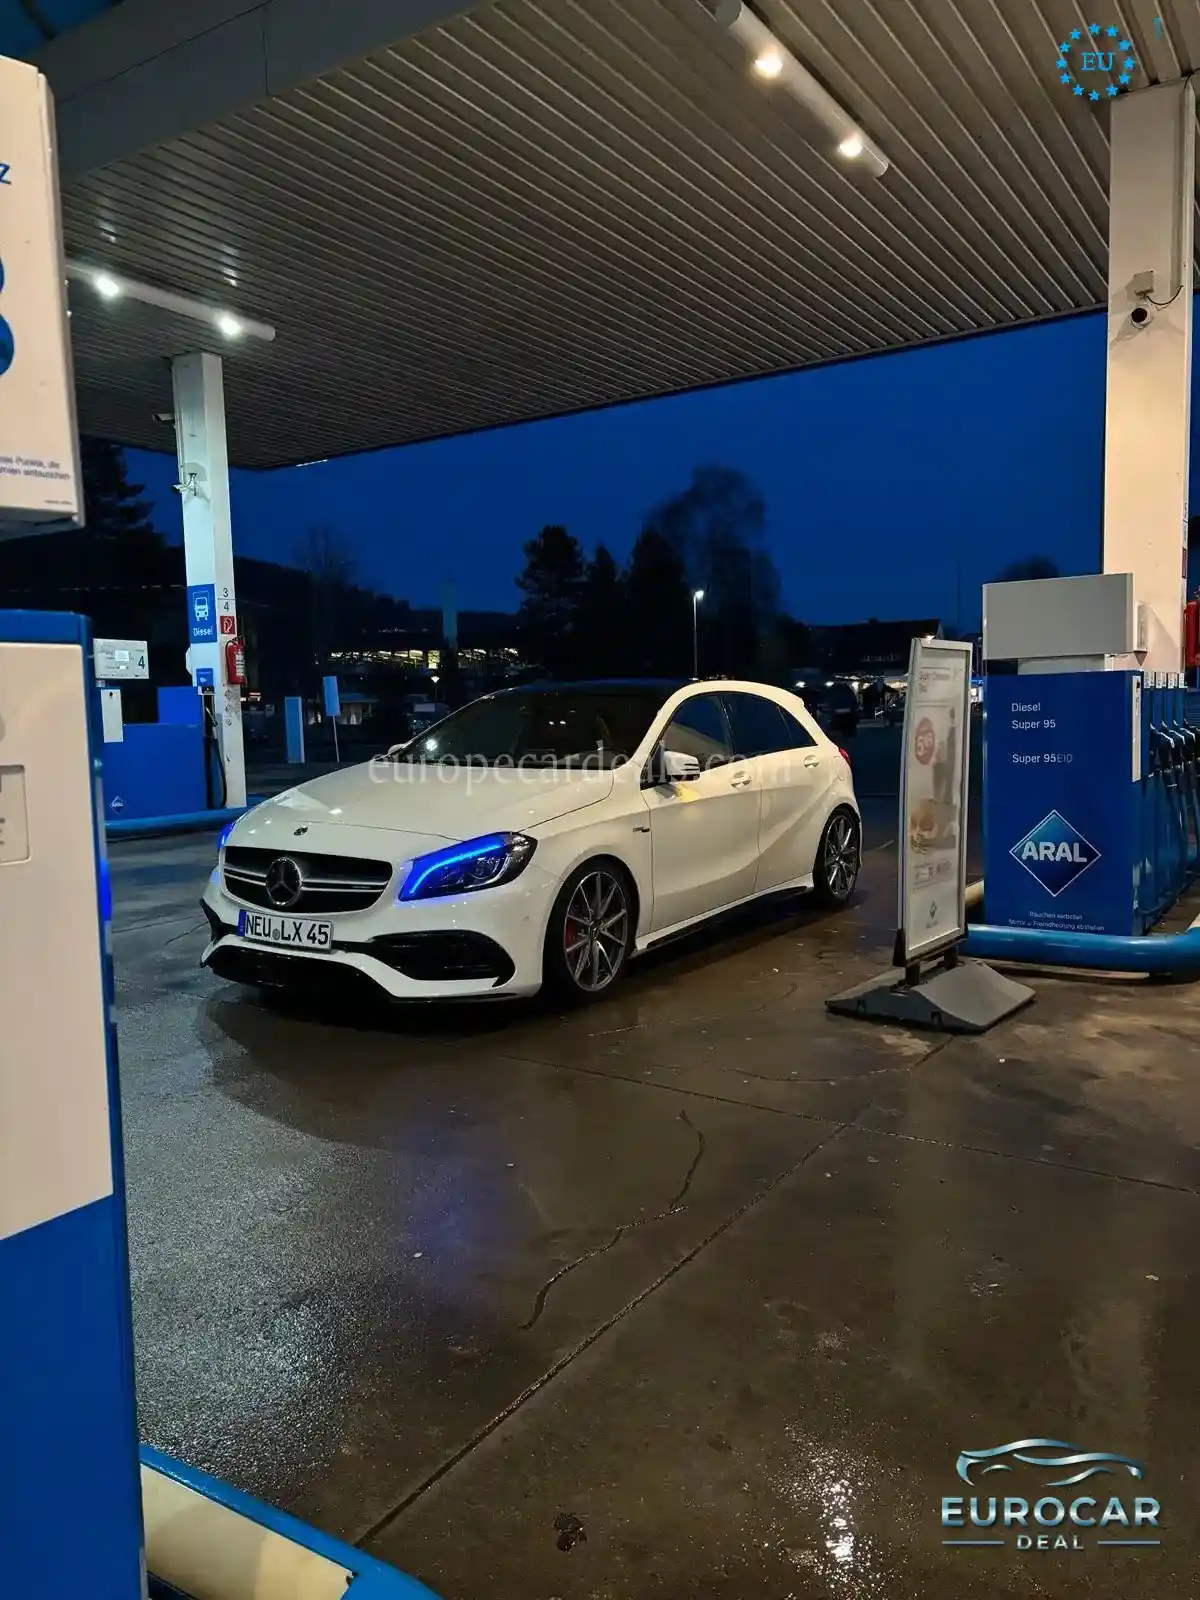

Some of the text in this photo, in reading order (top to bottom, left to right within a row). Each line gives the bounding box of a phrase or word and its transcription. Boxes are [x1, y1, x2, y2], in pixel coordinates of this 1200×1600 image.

[222, 587, 229, 598] 3
[223, 601, 230, 612] 4
[193, 626, 213, 637] Diesel
[138, 655, 146, 670] 4
[1011, 702, 1041, 712] Diesel
[1011, 719, 1056, 731] Super 95
[1012, 752, 1041, 765] Super
[1021, 840, 1088, 863] ARAL
[246, 915, 329, 945] NEU LX 45
